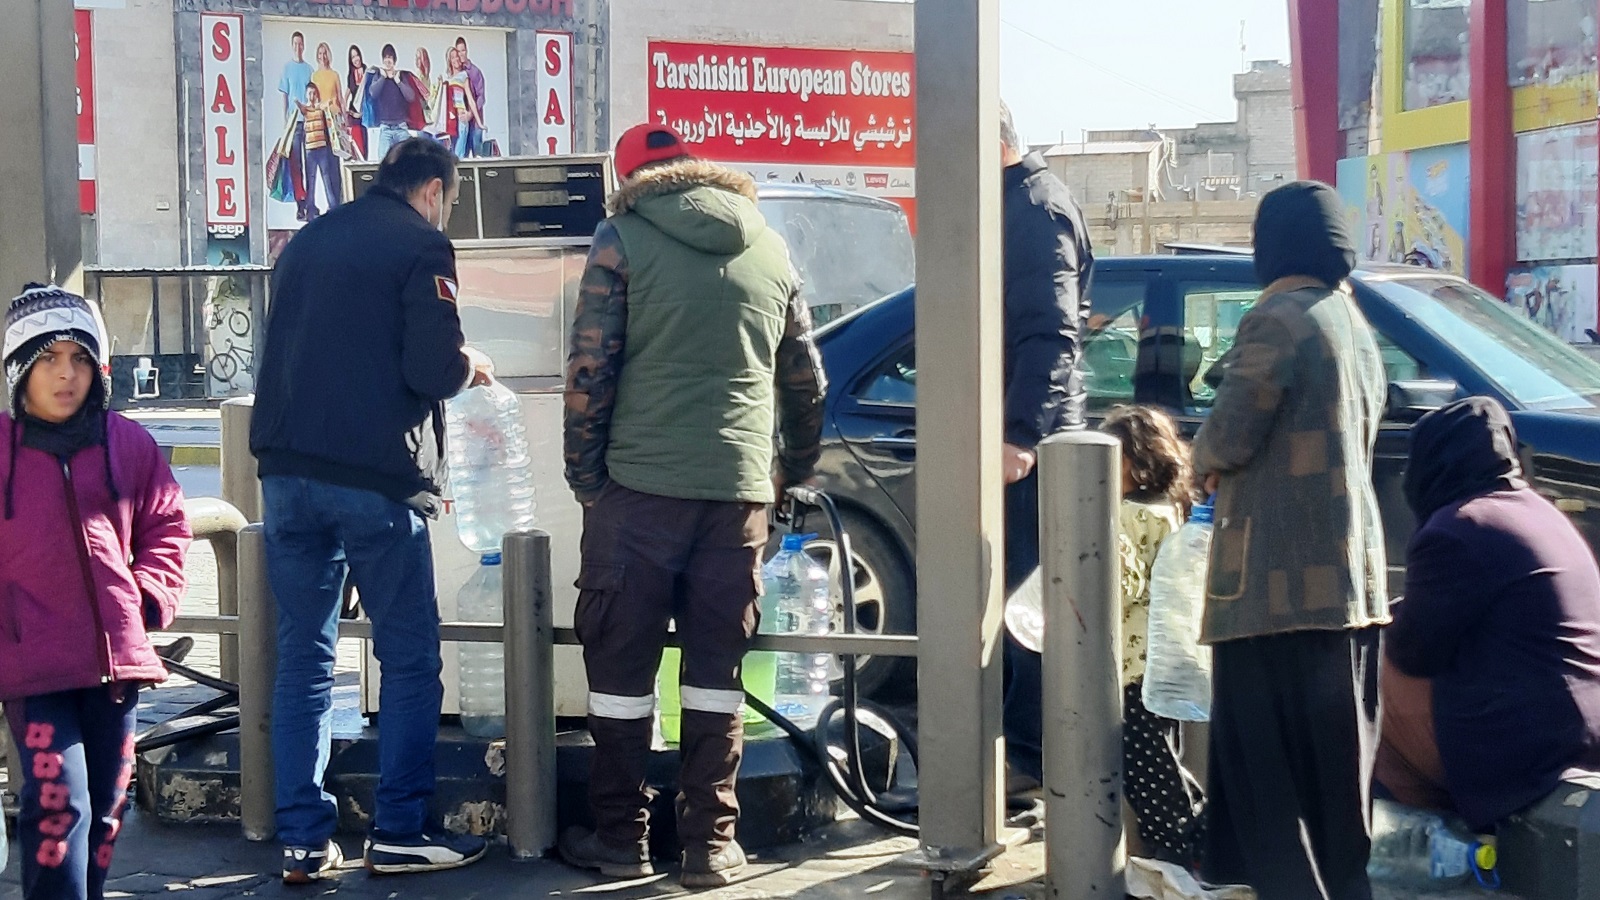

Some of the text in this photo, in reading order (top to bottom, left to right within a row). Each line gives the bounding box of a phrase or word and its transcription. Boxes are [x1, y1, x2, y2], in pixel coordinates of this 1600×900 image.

[652, 52, 911, 102] Tarshishi European Stores
[210, 21, 237, 218] SALE
[724, 107, 792, 146] والأحذية
[793, 110, 851, 147] للألبسة
[852, 113, 912, 152] ترشيشي
[207, 223, 245, 237] Jeep
